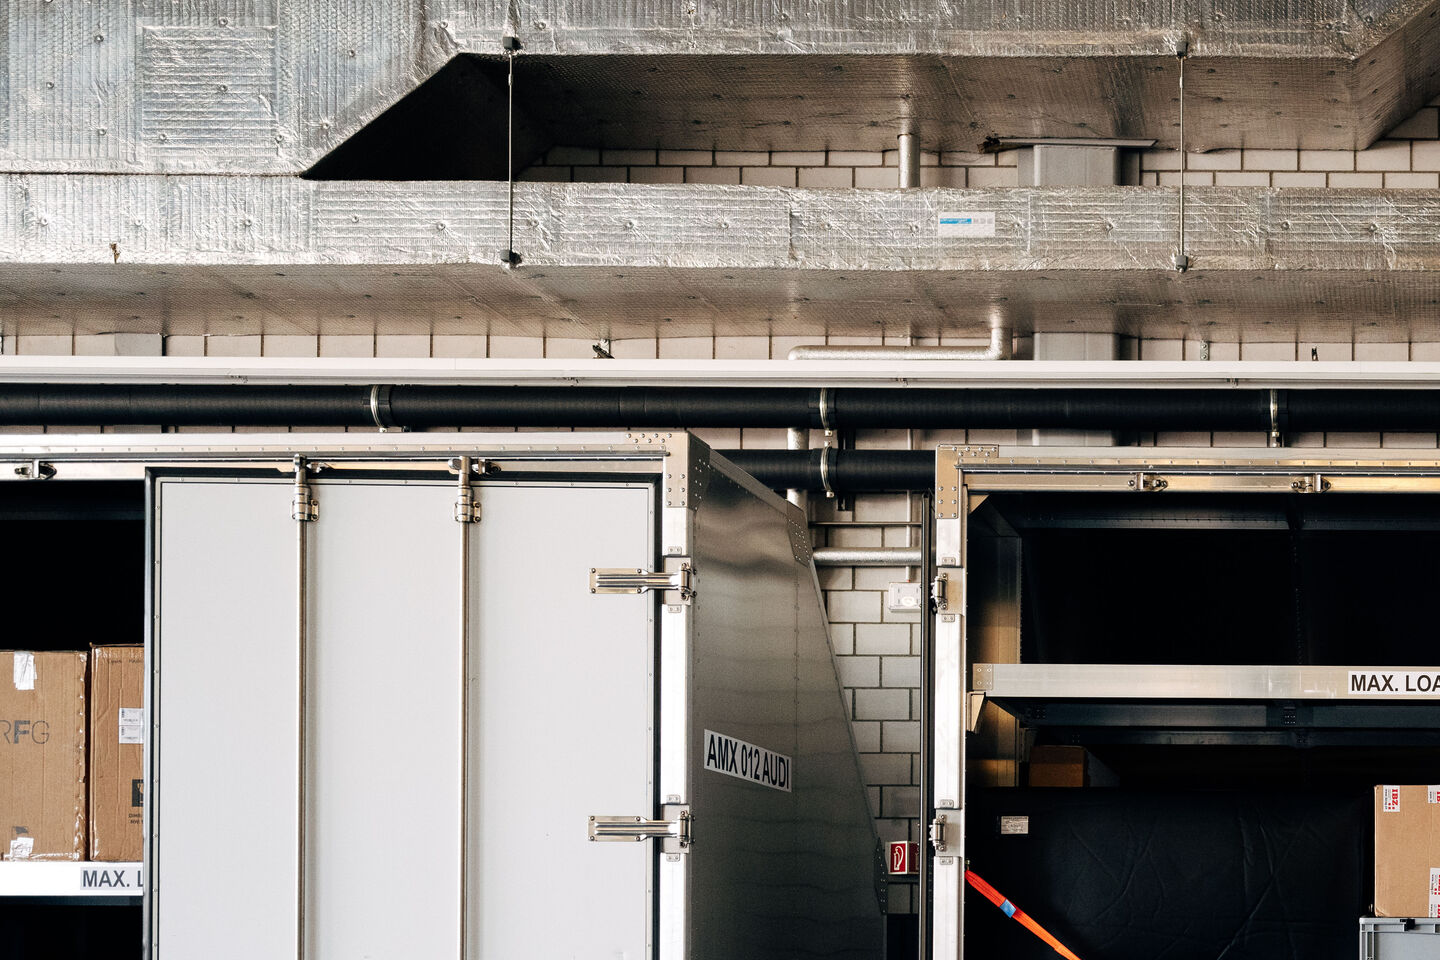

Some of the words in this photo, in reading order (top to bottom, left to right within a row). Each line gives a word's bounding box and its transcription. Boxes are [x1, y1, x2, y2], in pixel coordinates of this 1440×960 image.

[1351, 674, 1399, 692] MAX.
[706, 733, 738, 775] AMX
[741, 744, 760, 781] 012
[762, 751, 790, 790] AUDI
[82, 870, 130, 888] MAX.
